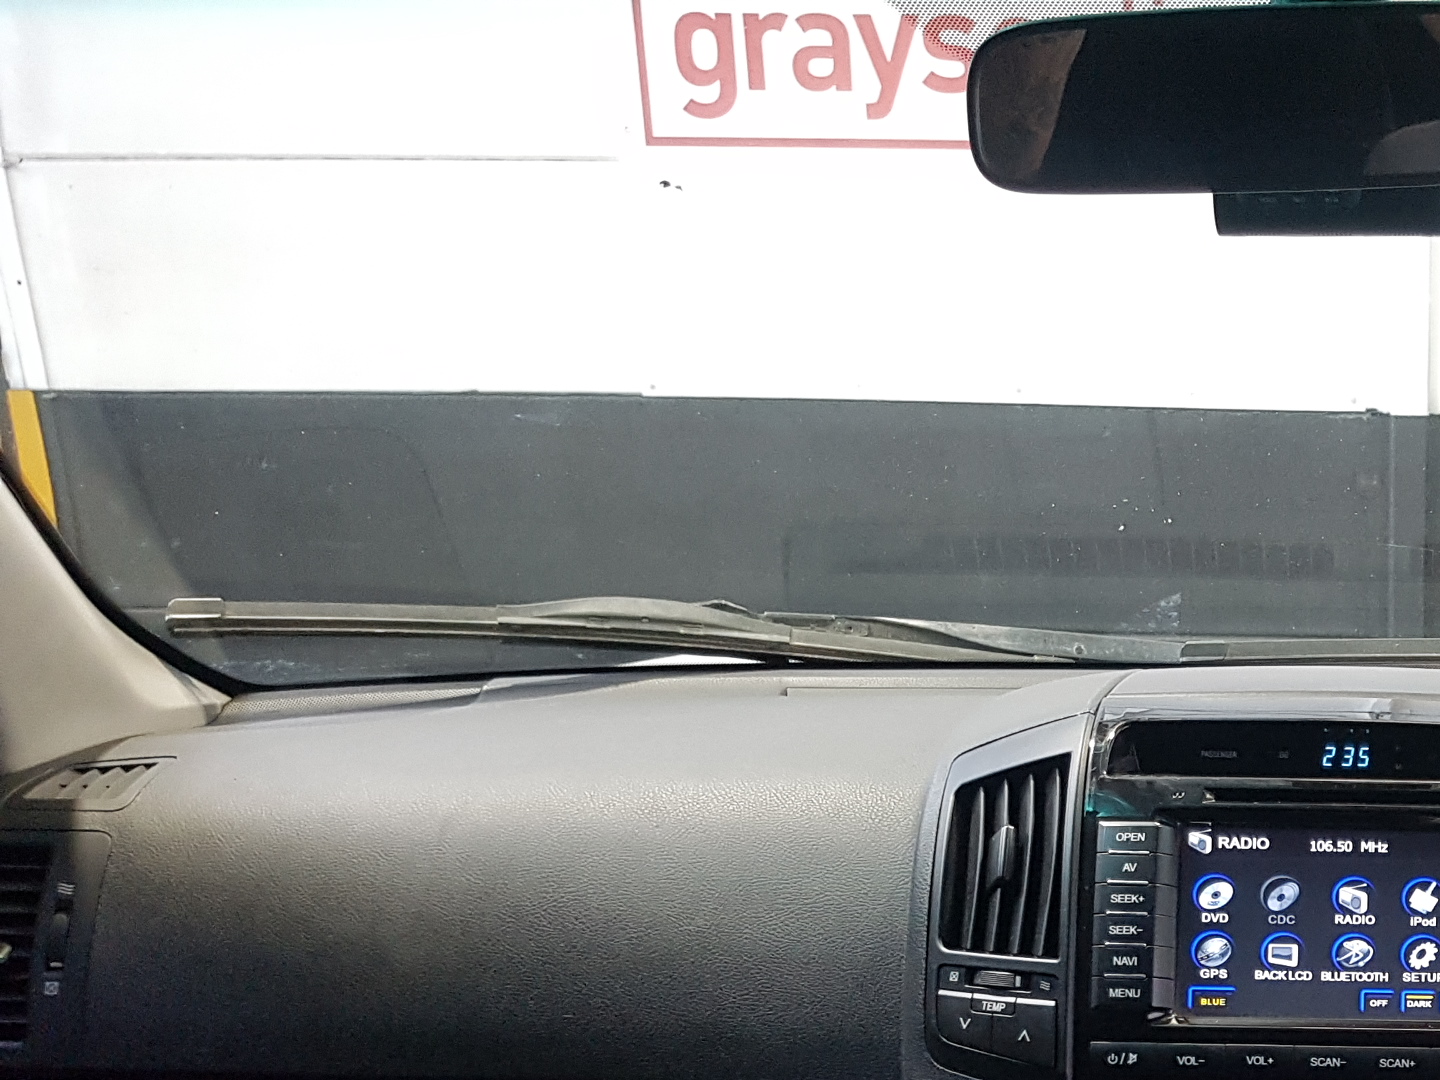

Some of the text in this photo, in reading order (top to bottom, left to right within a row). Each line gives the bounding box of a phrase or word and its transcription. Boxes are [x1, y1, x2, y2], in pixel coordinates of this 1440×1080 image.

[1116, 831, 1145, 842] OPEN
[1218, 837, 1269, 850] RADIO
[1310, 840, 1388, 853] 106.50 MHz
[1122, 862, 1137, 873] AV
[1110, 893, 1145, 904] SEEK+
[1202, 912, 1229, 923] DVD
[1268, 914, 1295, 925] CDC
[1335, 914, 1375, 925] RADIO
[1410, 915, 1436, 927] iPod
[1109, 924, 1143, 935] SEEK-
[1113, 955, 1138, 966] NAVI
[1200, 967, 1228, 979] GPS
[1321, 970, 1388, 981] BLUETOOTH
[1109, 987, 1140, 998] MENU
[982, 1001, 1006, 1012] TEMP
[1201, 997, 1226, 1006] BLUE
[1369, 999, 1388, 1008] OFF
[1406, 1000, 1432, 1009] DARK
[1177, 1056, 1205, 1066] VOL-
[1246, 1055, 1274, 1066] VOL+
[1310, 1057, 1347, 1067] SCAN-
[1379, 1058, 1416, 1069] SCAN+
